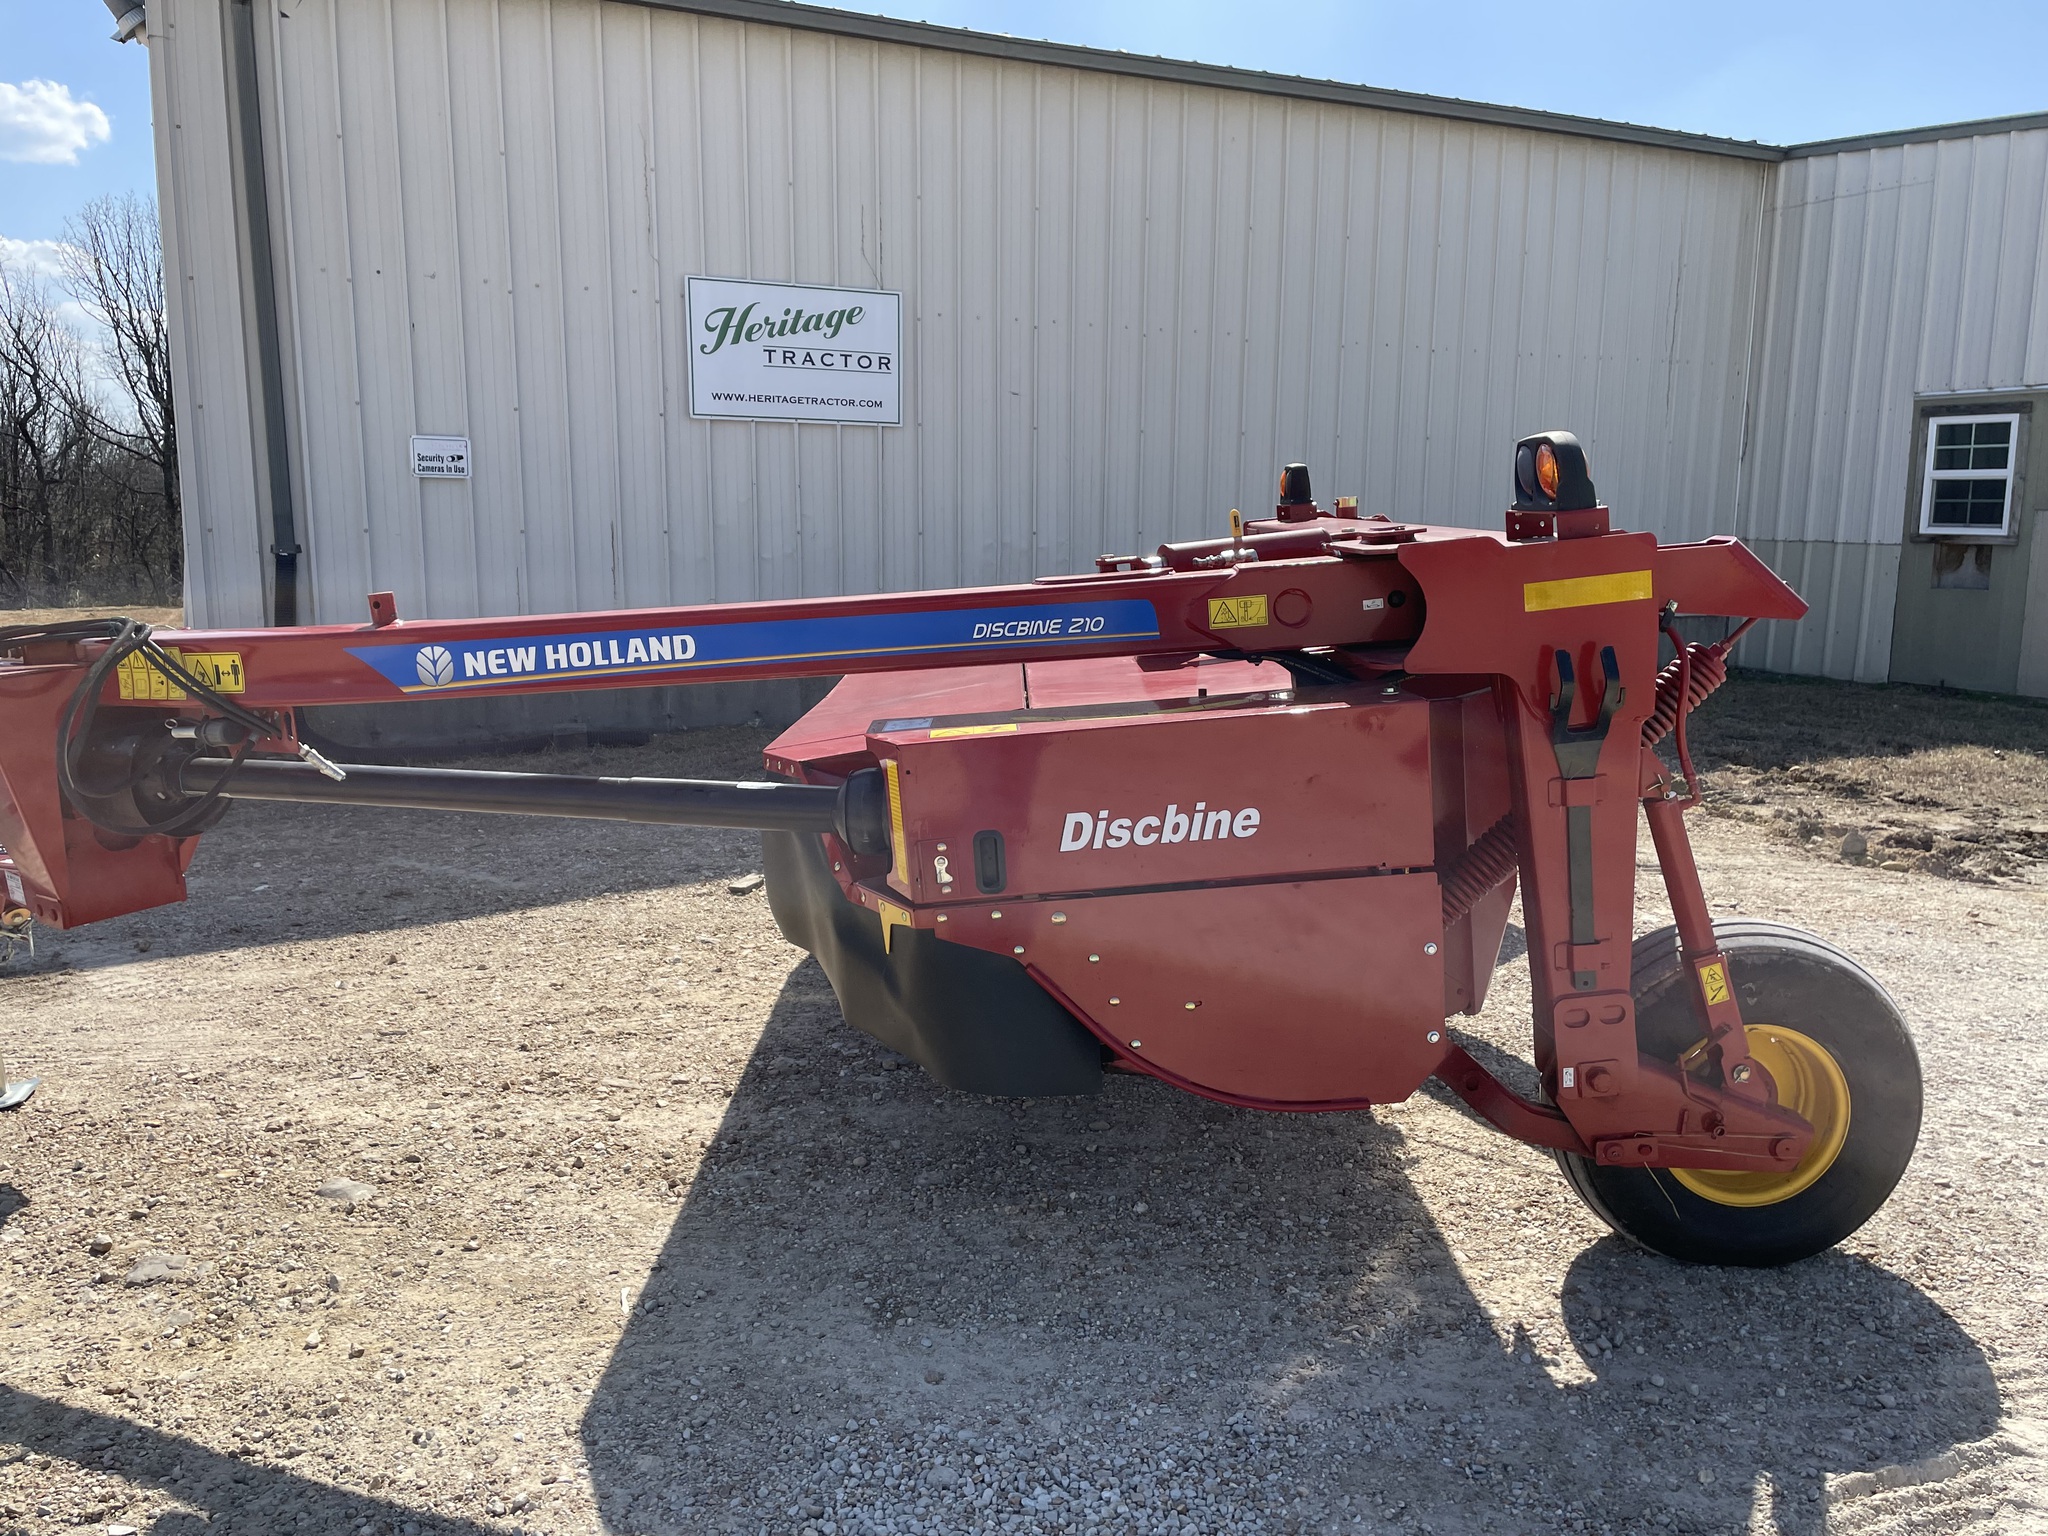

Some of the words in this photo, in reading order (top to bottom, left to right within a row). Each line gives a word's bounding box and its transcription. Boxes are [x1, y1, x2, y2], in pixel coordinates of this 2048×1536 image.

[699, 301, 866, 354] Heritage
[763, 348, 891, 370] TRACTOR
[711, 392, 883, 408] WWW.HERITAGETRACTOR.COM
[417, 453, 444, 464] Security
[417, 463, 445, 473] Cameras
[446, 464, 453, 473] In
[453, 465, 465, 473] Use
[972, 618, 1063, 639] DISCBINE
[1068, 616, 1105, 634] 210
[463, 645, 537, 677] NEW
[545, 634, 696, 670] HOLLAND
[1059, 801, 1261, 852] Discbine
